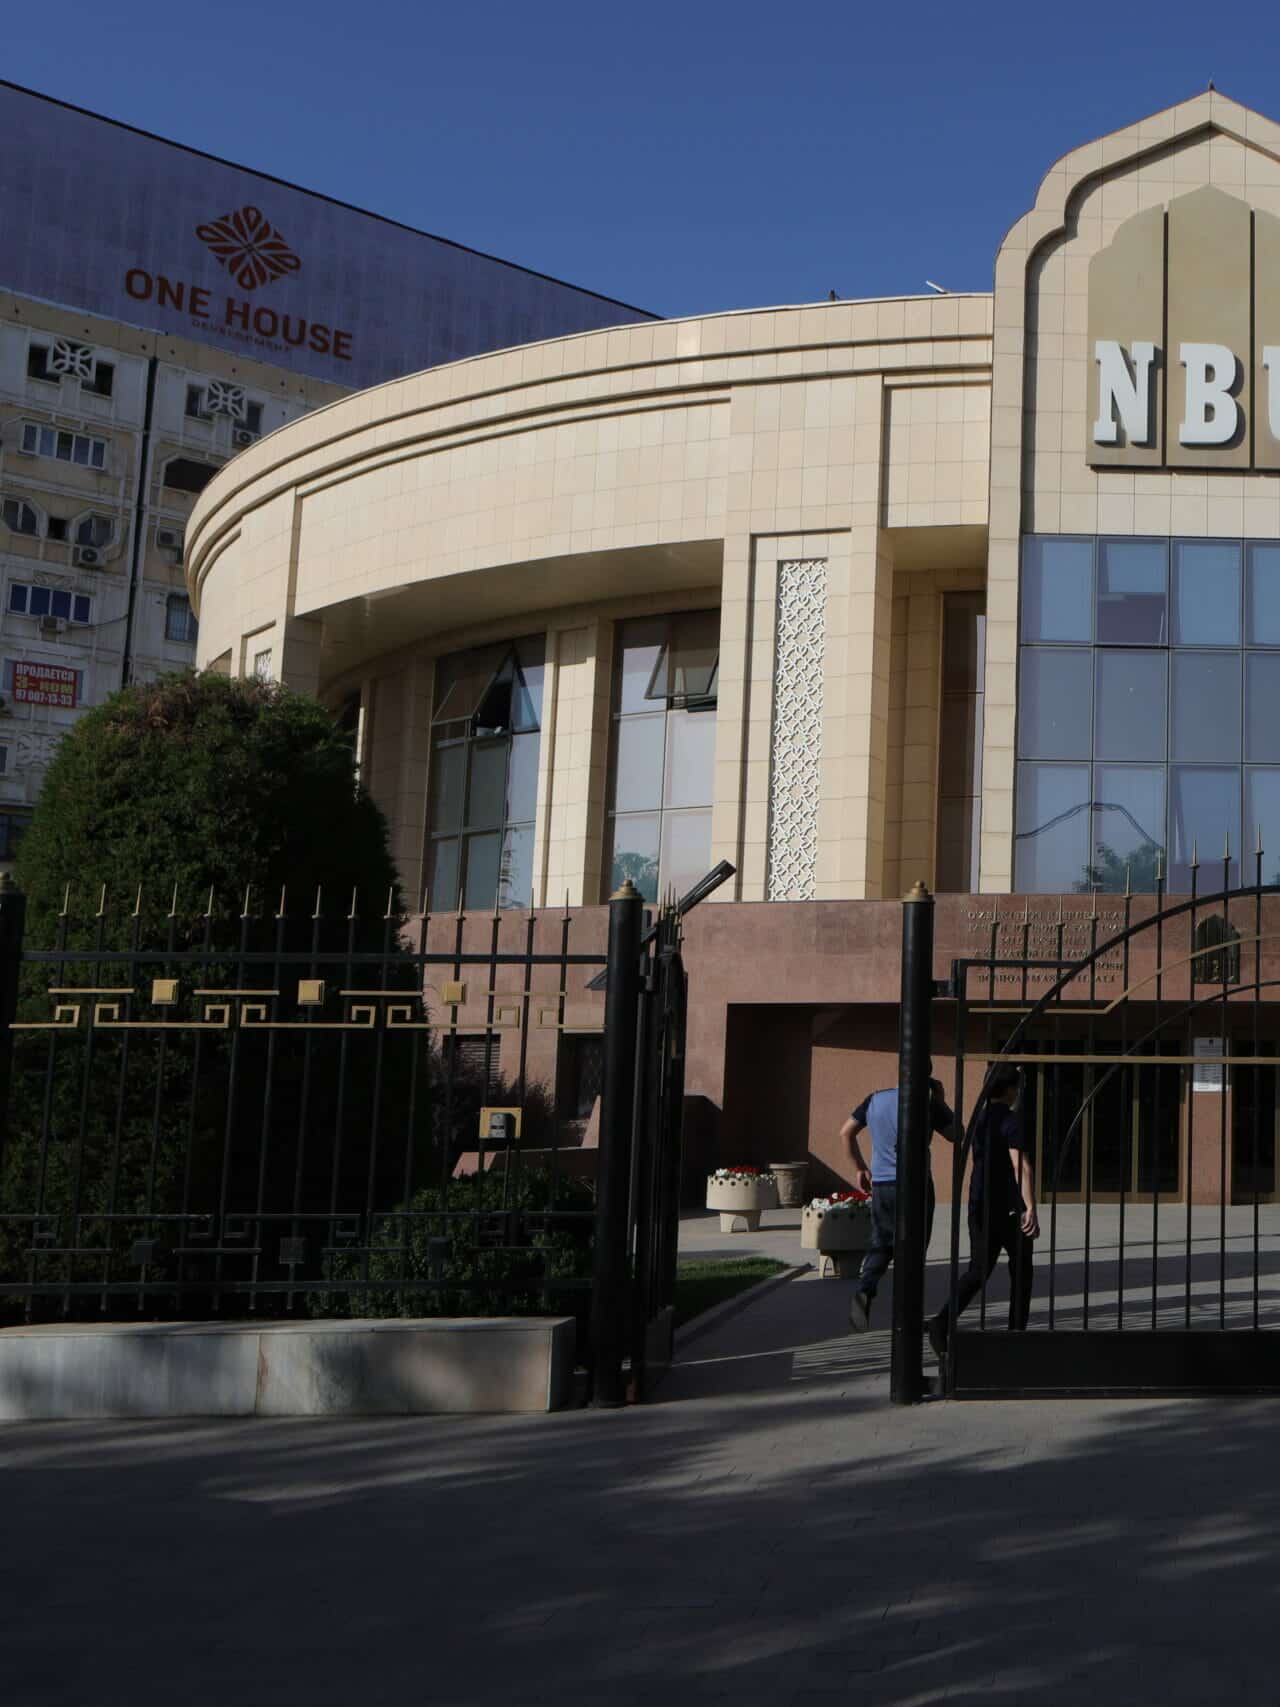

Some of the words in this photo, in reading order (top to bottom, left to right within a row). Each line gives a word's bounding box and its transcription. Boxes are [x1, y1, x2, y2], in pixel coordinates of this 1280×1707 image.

[126, 268, 211, 318] ONE
[225, 297, 353, 361] HOUSE
[16, 663, 75, 681] ПРОДАЕТСЯ
